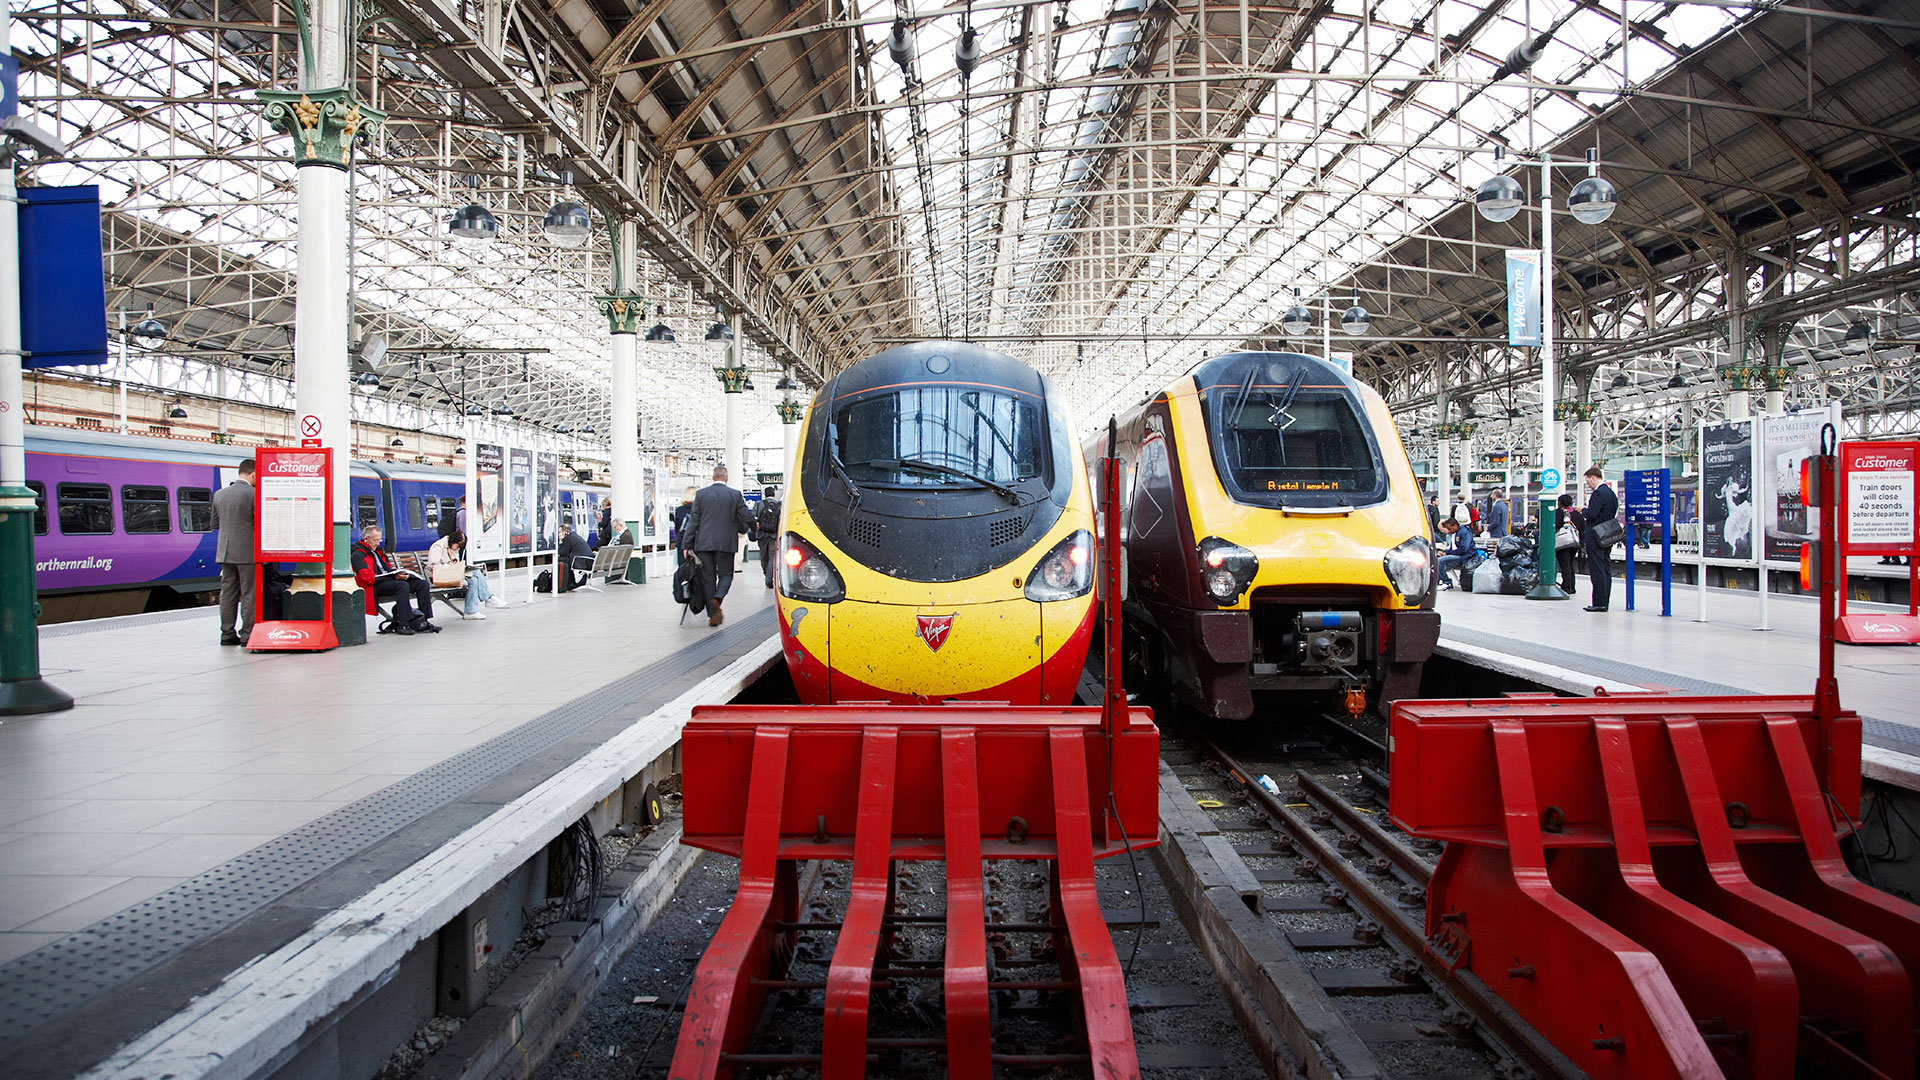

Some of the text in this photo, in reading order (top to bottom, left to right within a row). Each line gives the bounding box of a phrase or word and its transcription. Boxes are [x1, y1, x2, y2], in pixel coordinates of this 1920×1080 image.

[1513, 268, 1526, 328] Welcome
[1786, 422, 1811, 431] MATTER
[1812, 420, 1820, 429] OF
[1785, 434, 1799, 443] AND
[1706, 452, 1734, 463] Gershwin
[1855, 457, 1909, 468] Customer
[268, 462, 320, 473] Customer
[36, 556, 113, 571] orthernrail.org
[923, 619, 949, 642] Virgin
